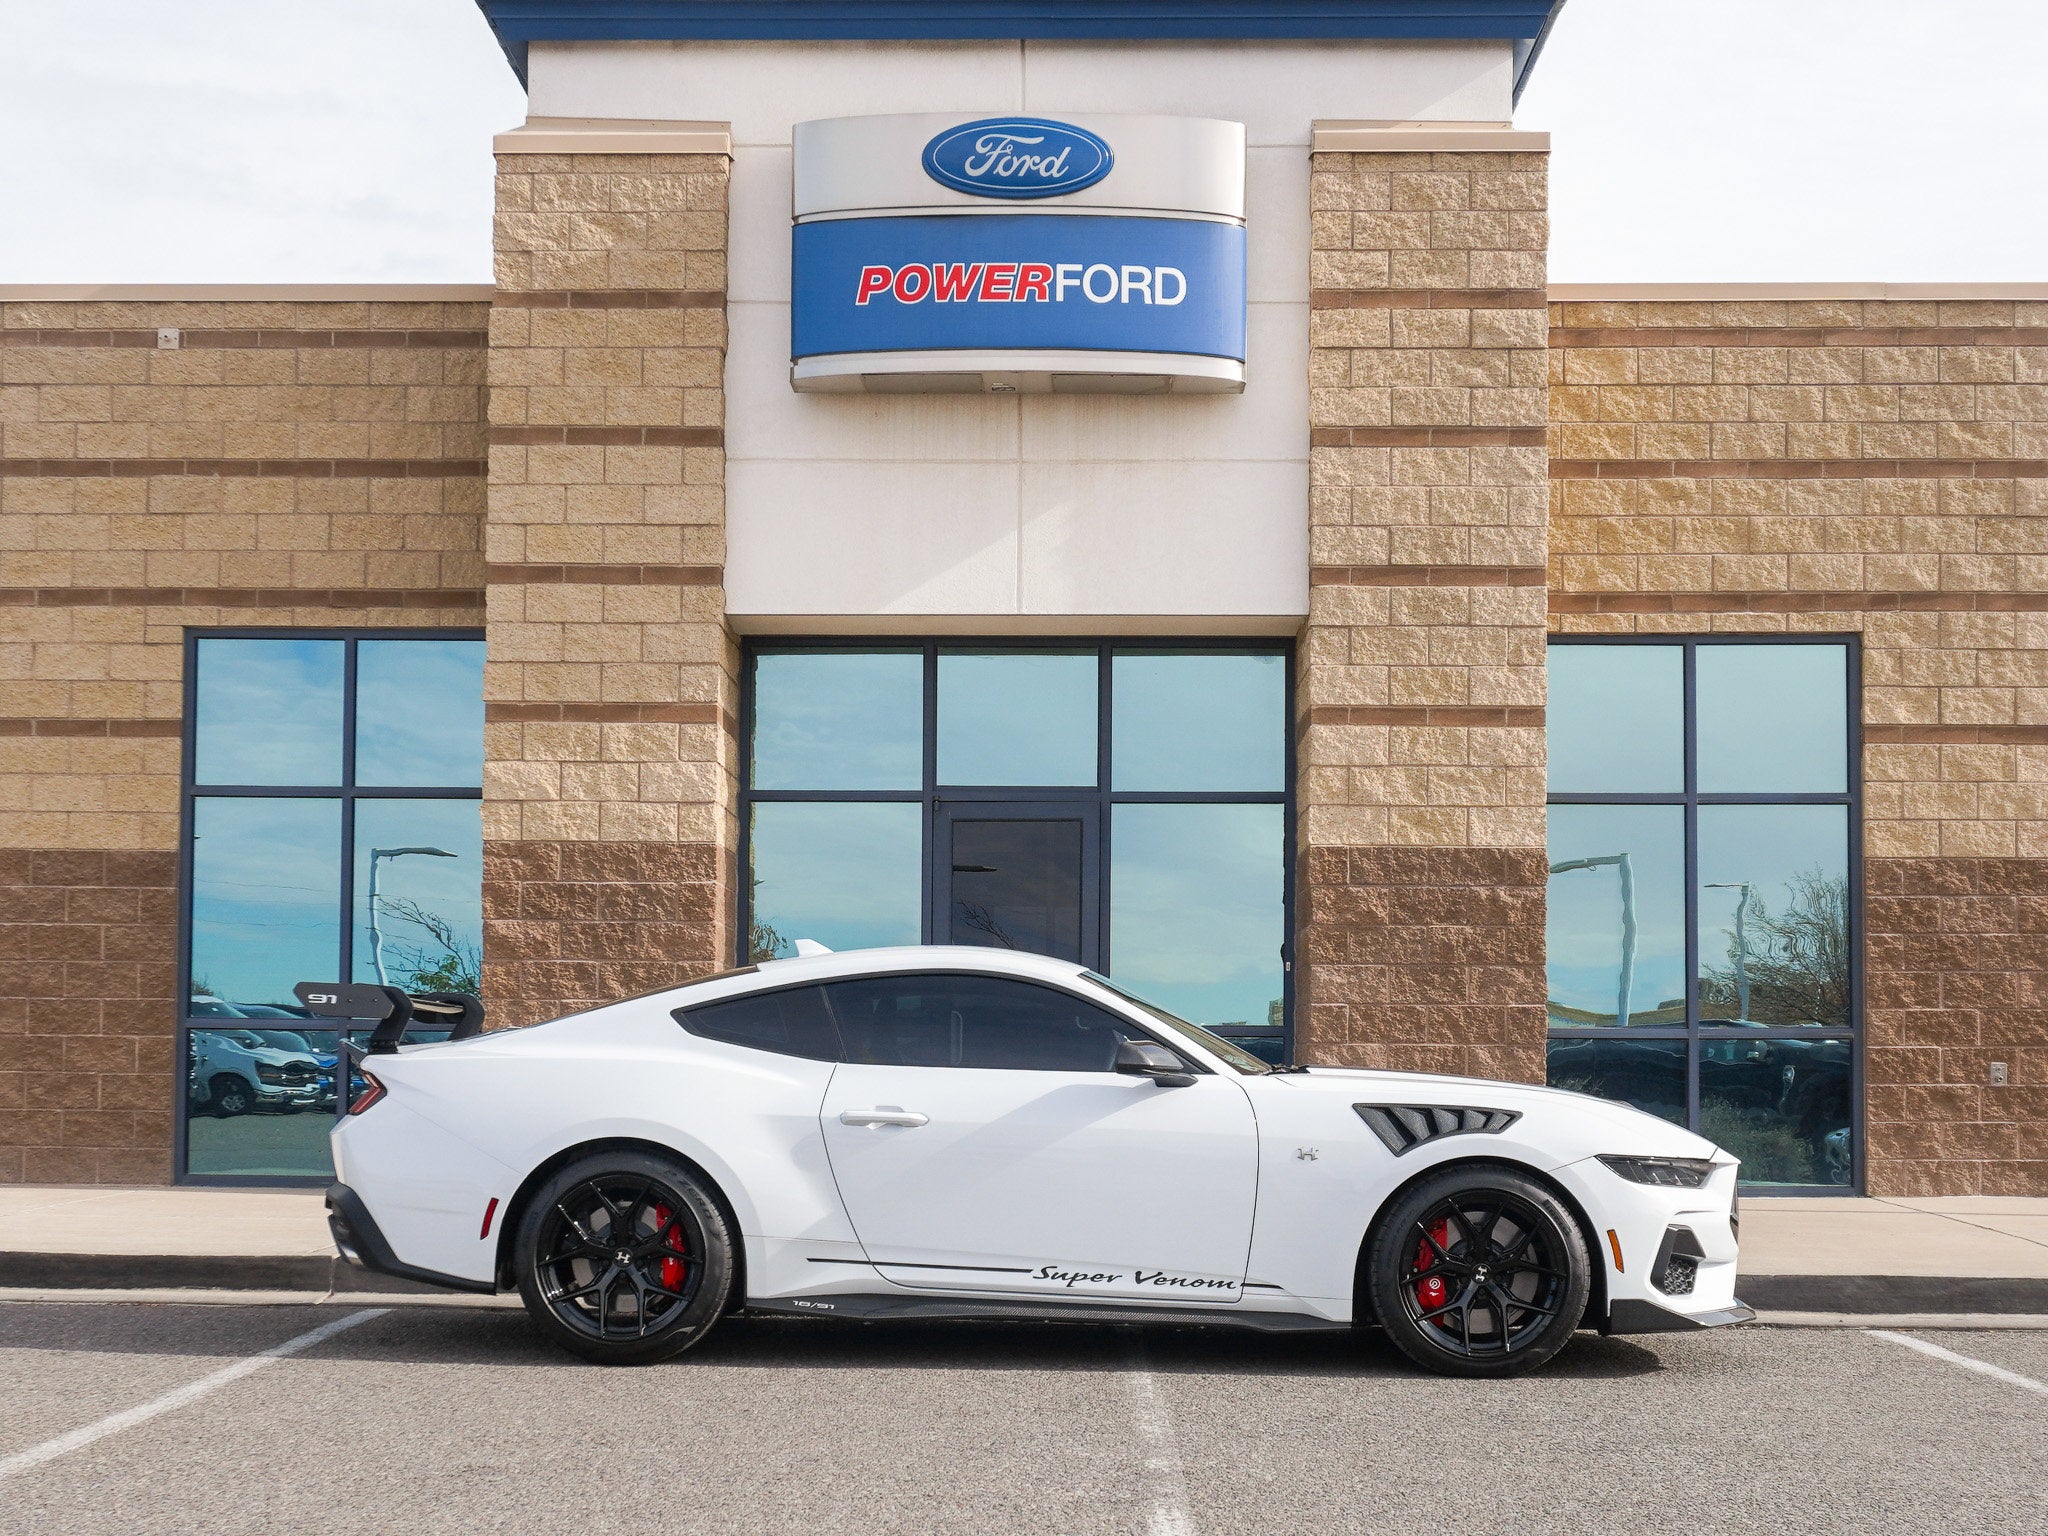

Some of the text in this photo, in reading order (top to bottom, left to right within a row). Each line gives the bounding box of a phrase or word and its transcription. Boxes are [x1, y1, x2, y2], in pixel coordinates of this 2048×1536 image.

[963, 133, 1072, 178] Ford
[307, 993, 338, 1004] 91
[1032, 1265, 1237, 1290] Super Venom
